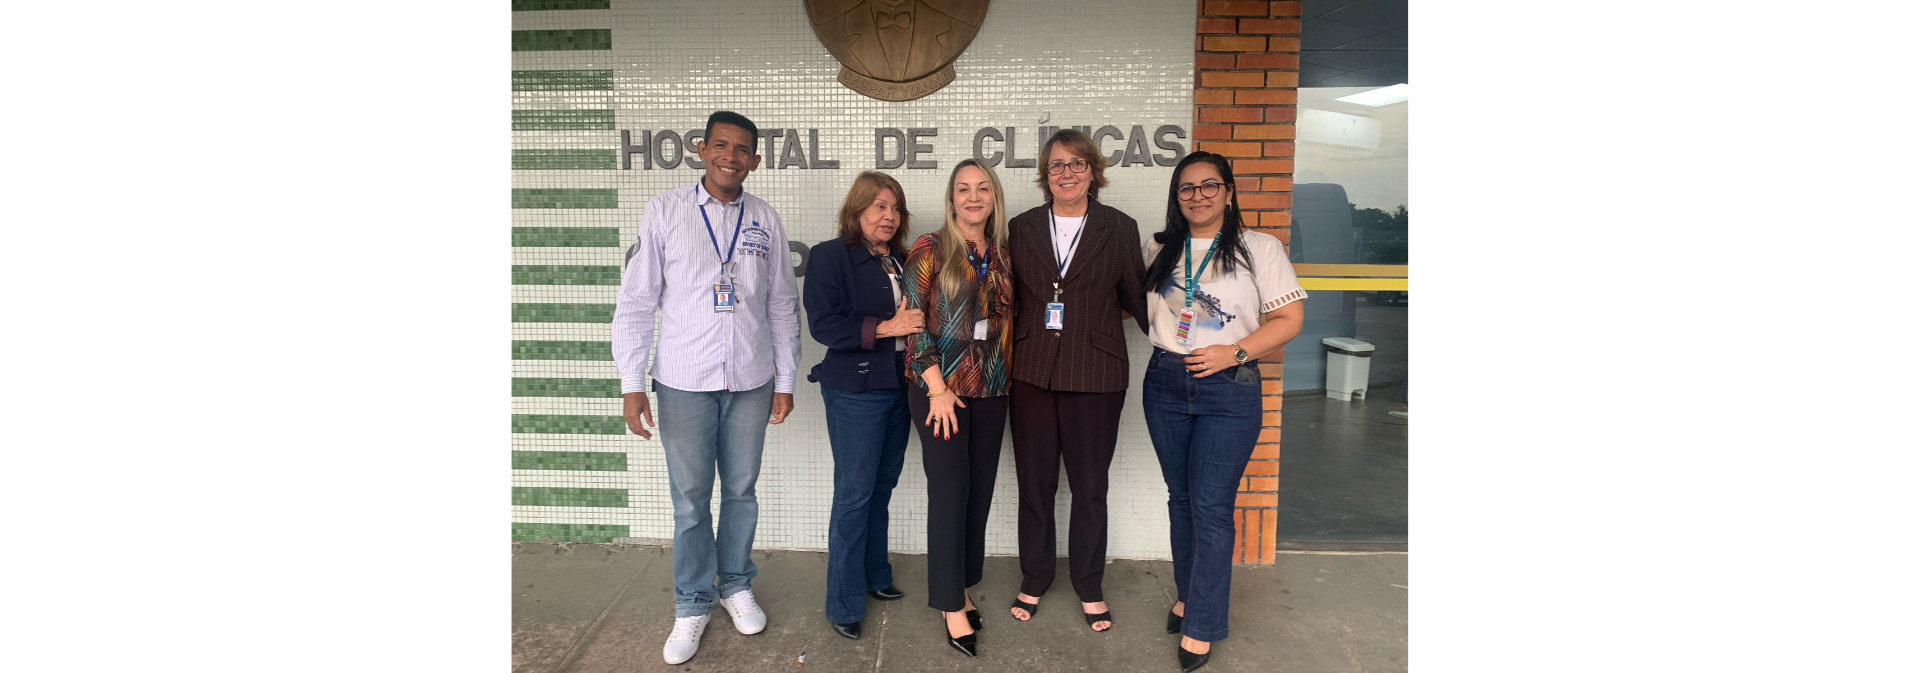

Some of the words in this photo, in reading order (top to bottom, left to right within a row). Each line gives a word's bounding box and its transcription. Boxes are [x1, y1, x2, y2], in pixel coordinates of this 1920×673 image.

[842, 70, 895, 97] GASPAR
[900, 70, 951, 97] VIANNA
[621, 128, 839, 169] HOSTAL
[875, 127, 938, 169] DE
[973, 111, 1186, 168] CLÍCAS
